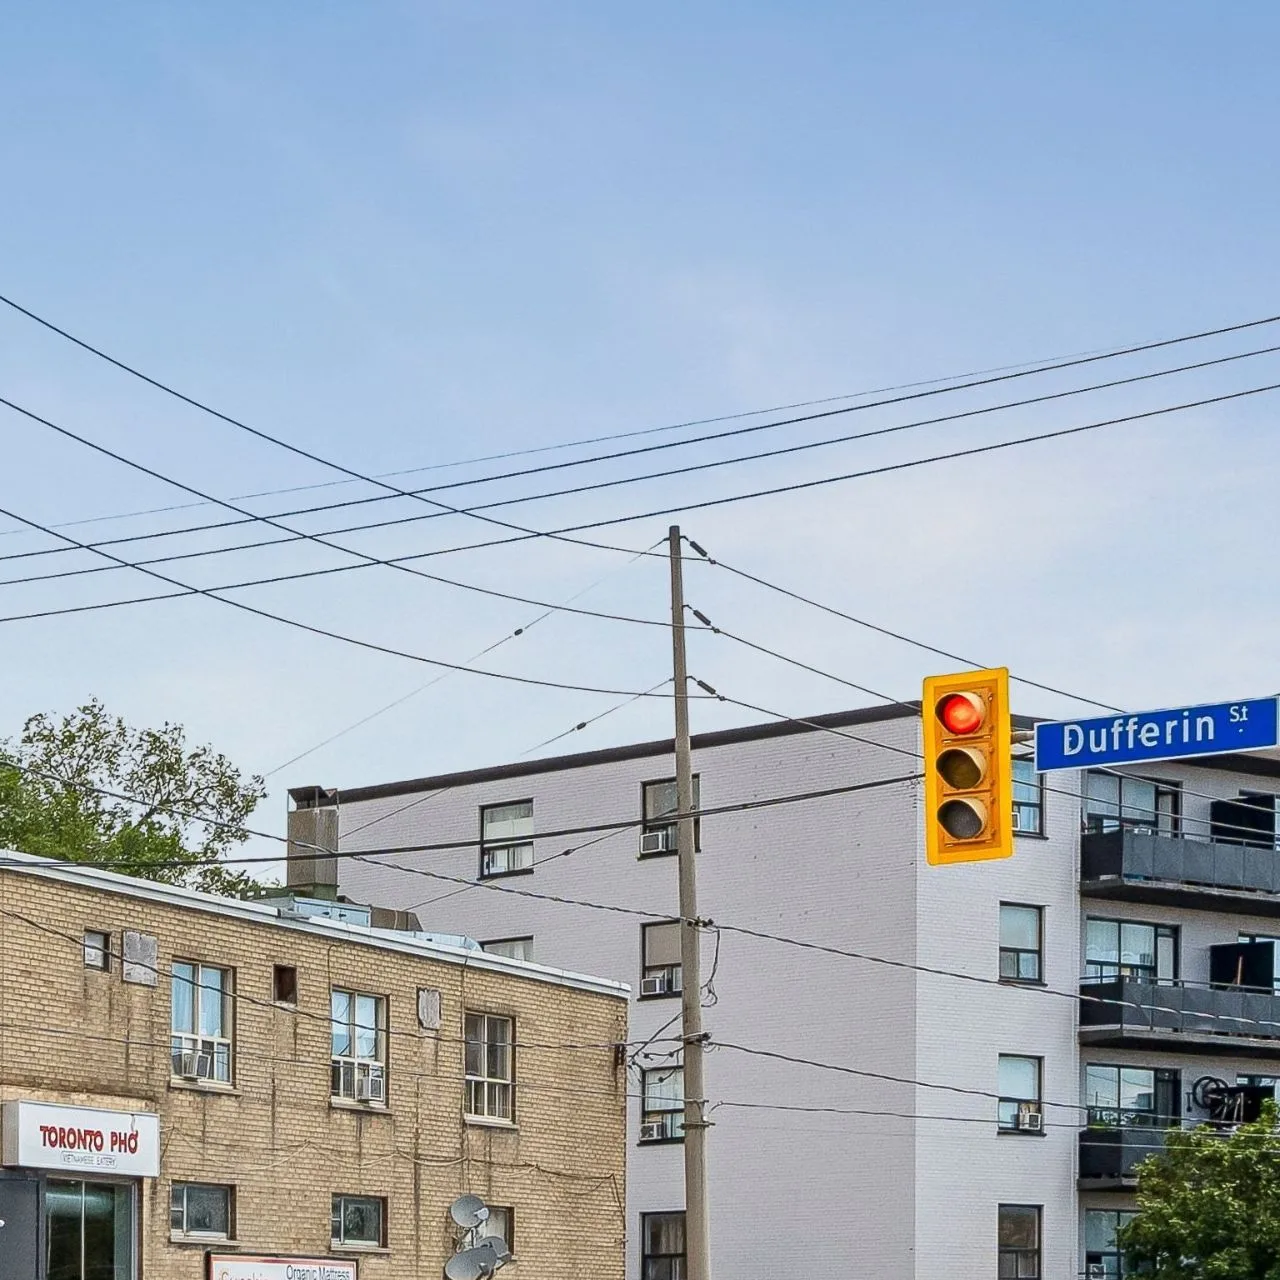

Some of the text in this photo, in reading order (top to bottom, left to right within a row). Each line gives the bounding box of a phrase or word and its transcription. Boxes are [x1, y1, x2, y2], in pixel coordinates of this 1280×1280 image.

[1063, 705, 1249, 756] Dufferin St
[40, 1125, 104, 1152] TORONTO
